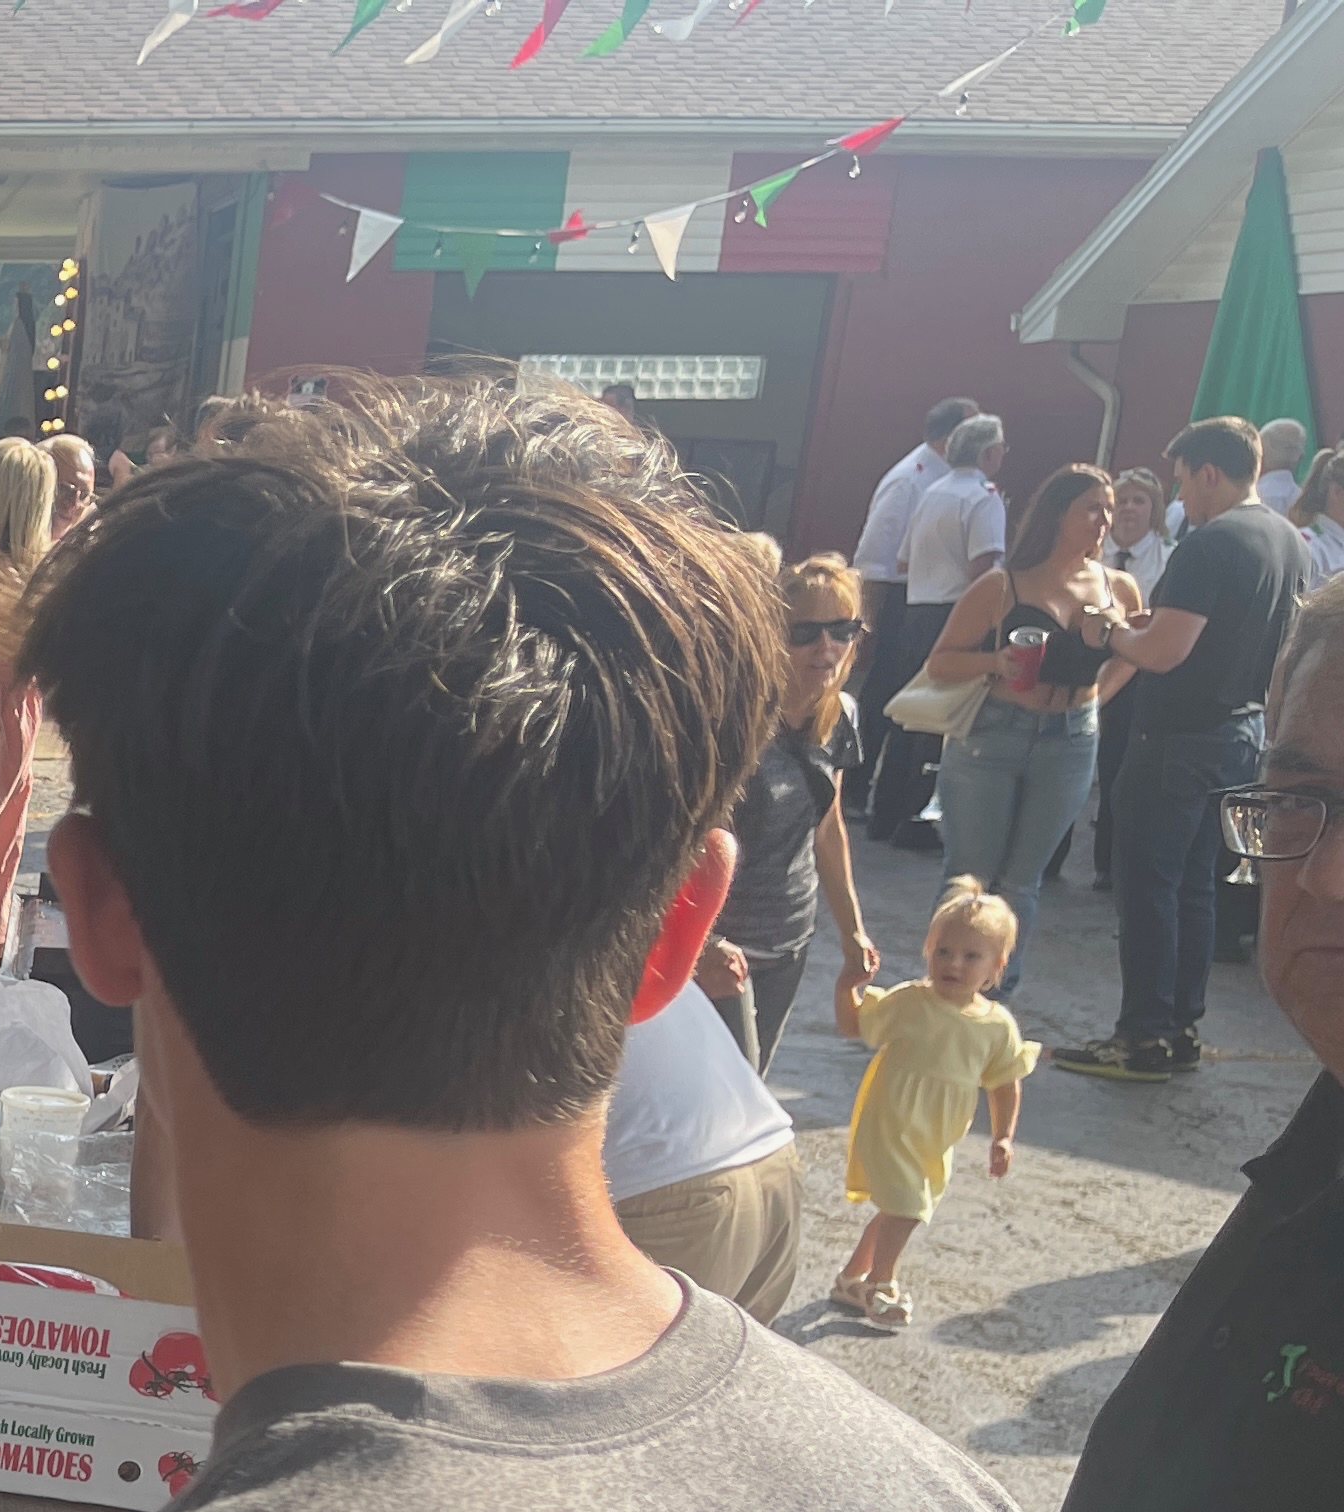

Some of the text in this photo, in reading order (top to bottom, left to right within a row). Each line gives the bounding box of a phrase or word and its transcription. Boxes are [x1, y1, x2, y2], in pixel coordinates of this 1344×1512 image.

[28, 1350, 70, 1375] Locally
[72, 1358, 107, 1380] Fresh
[10, 1420, 54, 1444] Locally
[55, 1426, 95, 1447] Grown
